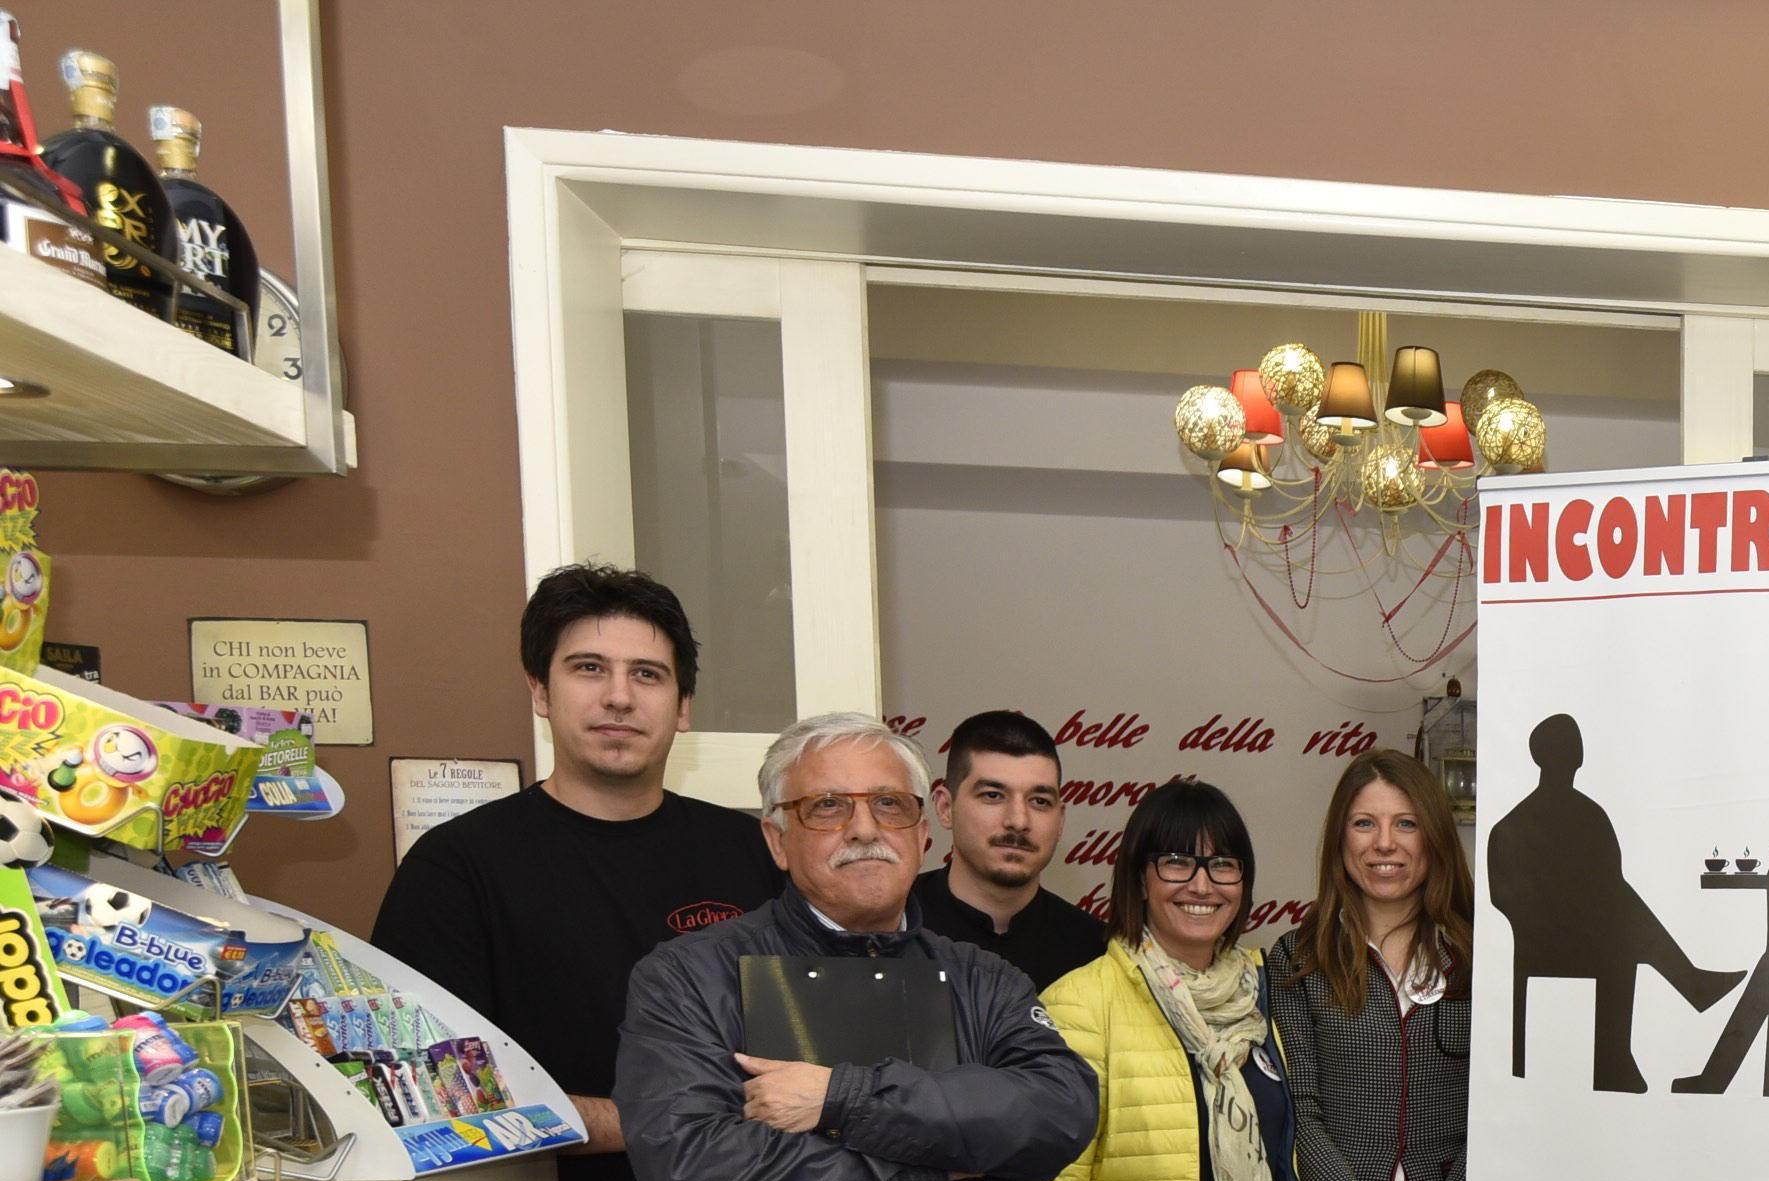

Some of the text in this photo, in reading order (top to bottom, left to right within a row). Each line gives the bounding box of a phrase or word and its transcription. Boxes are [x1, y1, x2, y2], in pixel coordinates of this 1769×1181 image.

[267, 314, 286, 337] 2
[283, 358, 302, 380] 3
[213, 641, 347, 658] CHI non beve
[202, 662, 361, 680] in COMPAGNIA
[222, 684, 343, 705] dal BAR può
[1055, 708, 1151, 749] belle
[1178, 714, 1275, 753] della
[1302, 721, 1378, 757] vita
[450, 769, 484, 780] REGOLE
